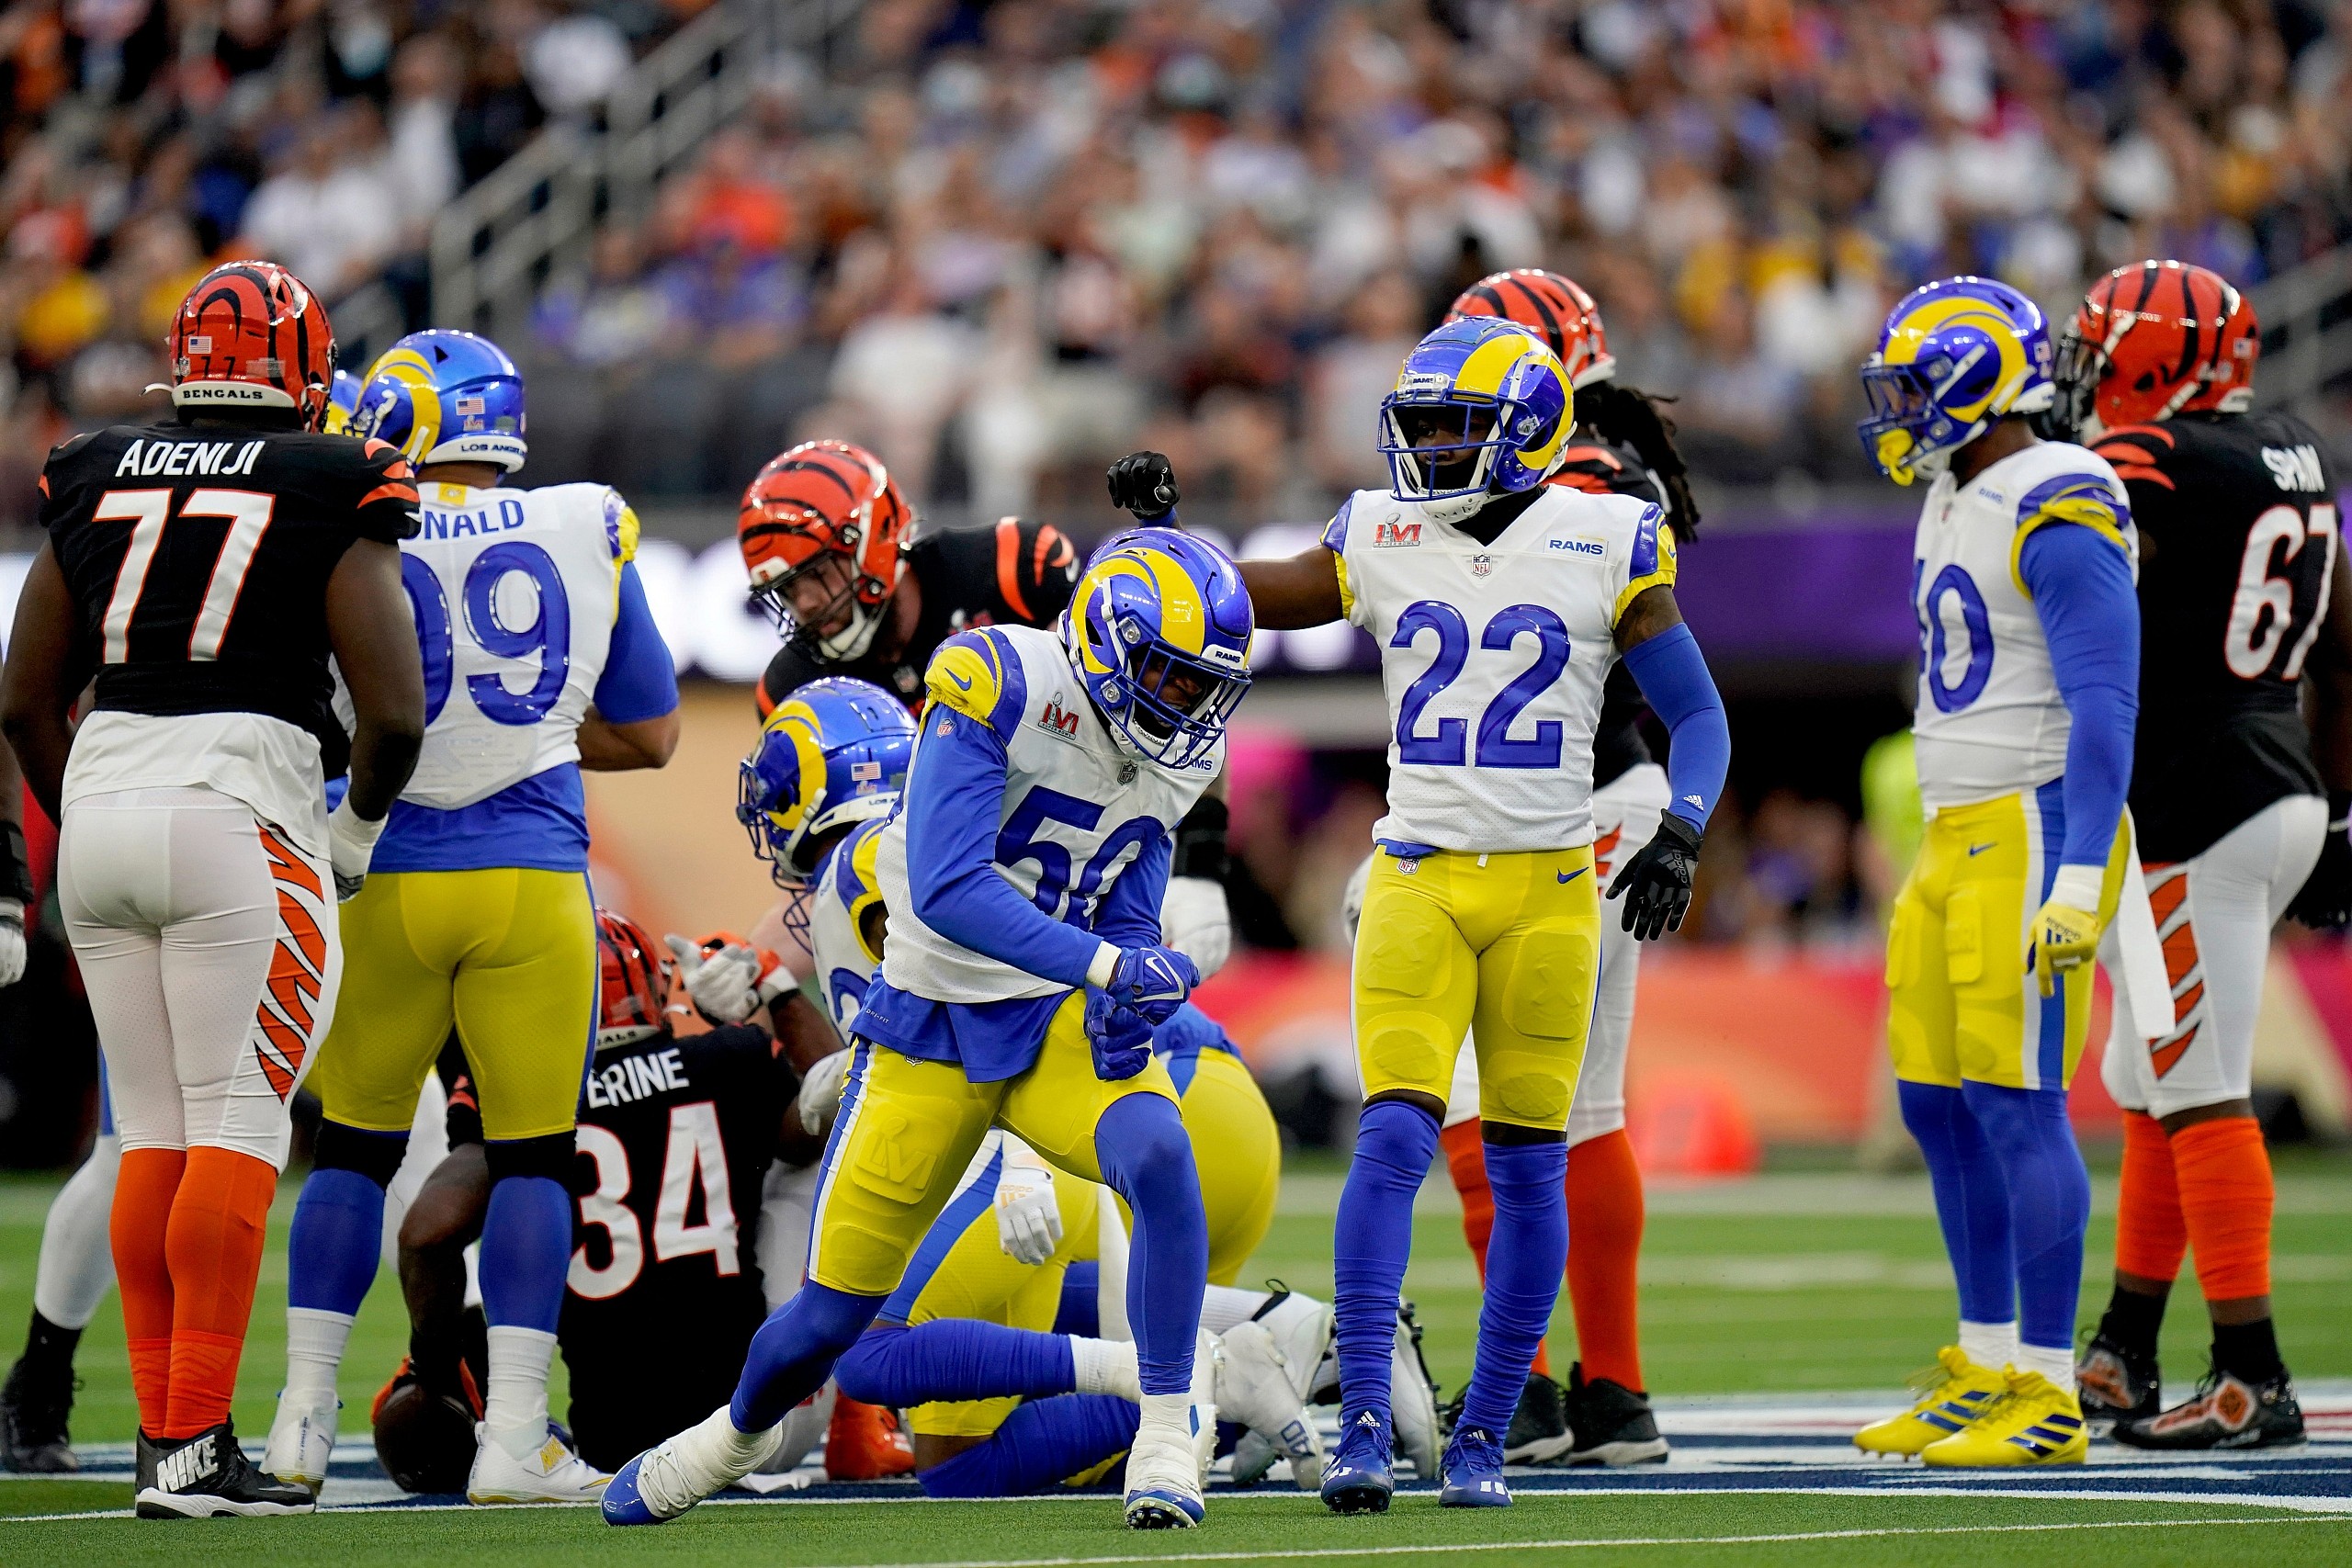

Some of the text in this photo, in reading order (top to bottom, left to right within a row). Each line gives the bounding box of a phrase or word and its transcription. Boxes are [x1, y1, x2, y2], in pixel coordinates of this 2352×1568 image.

[200, 355, 236, 379] 77
[183, 389, 264, 400] BENGALS
[115, 439, 266, 477] ADENIJI
[461, 444, 489, 452] LOS
[409, 500, 524, 542] NALD
[1375, 524, 1421, 543] LVI
[1549, 539, 1604, 555] RAMS
[92, 487, 276, 665] 77
[2224, 502, 2338, 681] 67
[1215, 650, 1241, 663] RAMS
[1389, 600, 1571, 769] 22
[1041, 702, 1080, 736] LVI
[1683, 795, 1704, 811] adidas
[994, 784, 1167, 933] 50
[865, 1009, 889, 1023] DRI-FIT
[587, 1048, 690, 1109] ERINE
[566, 1101, 741, 1301] 34
[156, 1434, 220, 1495] NIKE
